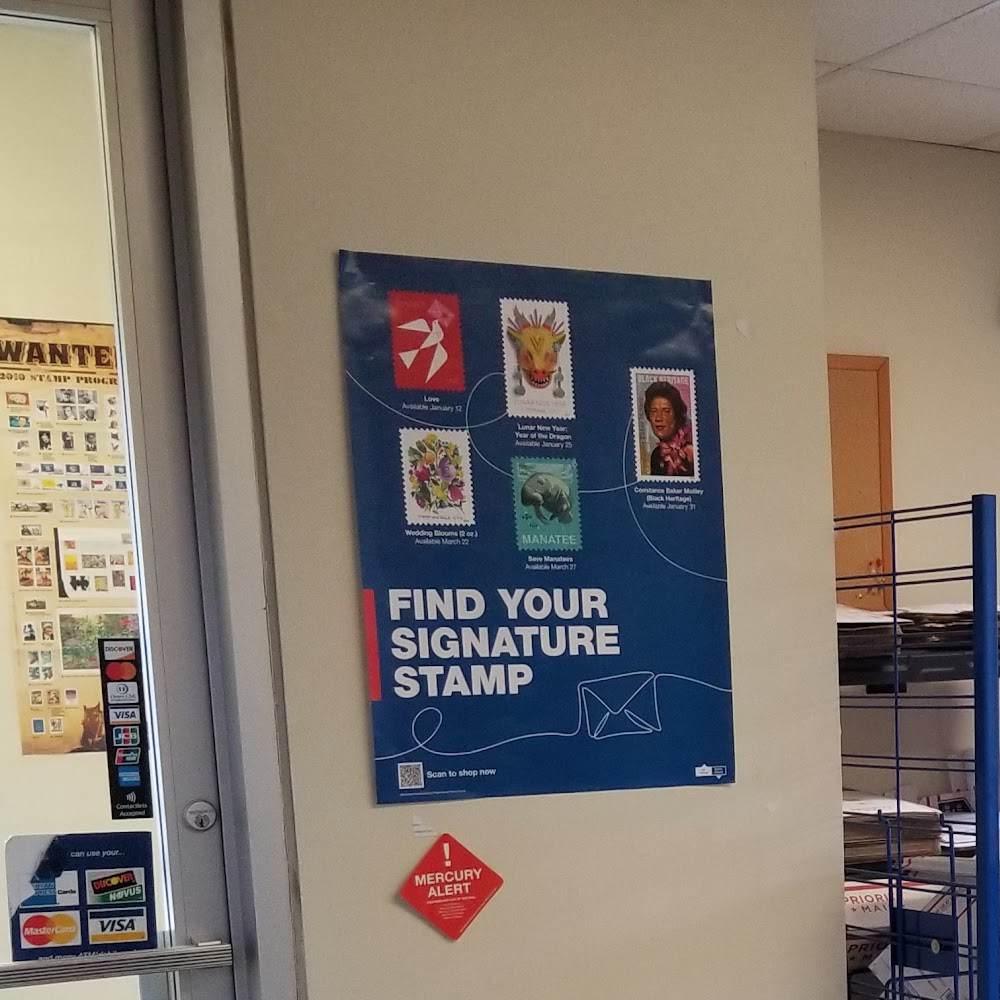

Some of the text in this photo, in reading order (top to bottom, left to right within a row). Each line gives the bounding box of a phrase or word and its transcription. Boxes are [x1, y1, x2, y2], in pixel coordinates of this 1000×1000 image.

[30, 374, 71, 383] STAMP
[424, 395, 440, 403] Love
[402, 402, 428, 411] Available
[429, 404, 454, 412] January
[517, 423, 536, 431] Lunar
[549, 433, 572, 441] Dragon
[515, 440, 540, 448] Available
[541, 441, 564, 449] January
[634, 487, 704, 496] Constance Baker Motley
[643, 502, 666, 510] Available
[667, 503, 688, 511] January
[405, 529, 433, 538] Wedding
[522, 534, 577, 545] MANATEE
[544, 555, 574, 563] Manatees
[525, 563, 550, 571] Available
[388, 588, 609, 621] FIND YOUR
[390, 624, 621, 660] SIGNATURE
[393, 664, 534, 698] STAMP
[113, 711, 137, 719] VISA
[117, 732, 138, 741] JCB
[426, 767, 497, 780] Scan to shop now
[116, 802, 147, 810] Contactless
[119, 809, 146, 817] Accepted
[93, 871, 134, 890] DISCOVER
[414, 868, 482, 886] MERCURY
[109, 886, 142, 901] NOVUS
[428, 882, 471, 898] ALERT
[99, 918, 136, 932] VISA
[23, 925, 76, 936] MasterCard
